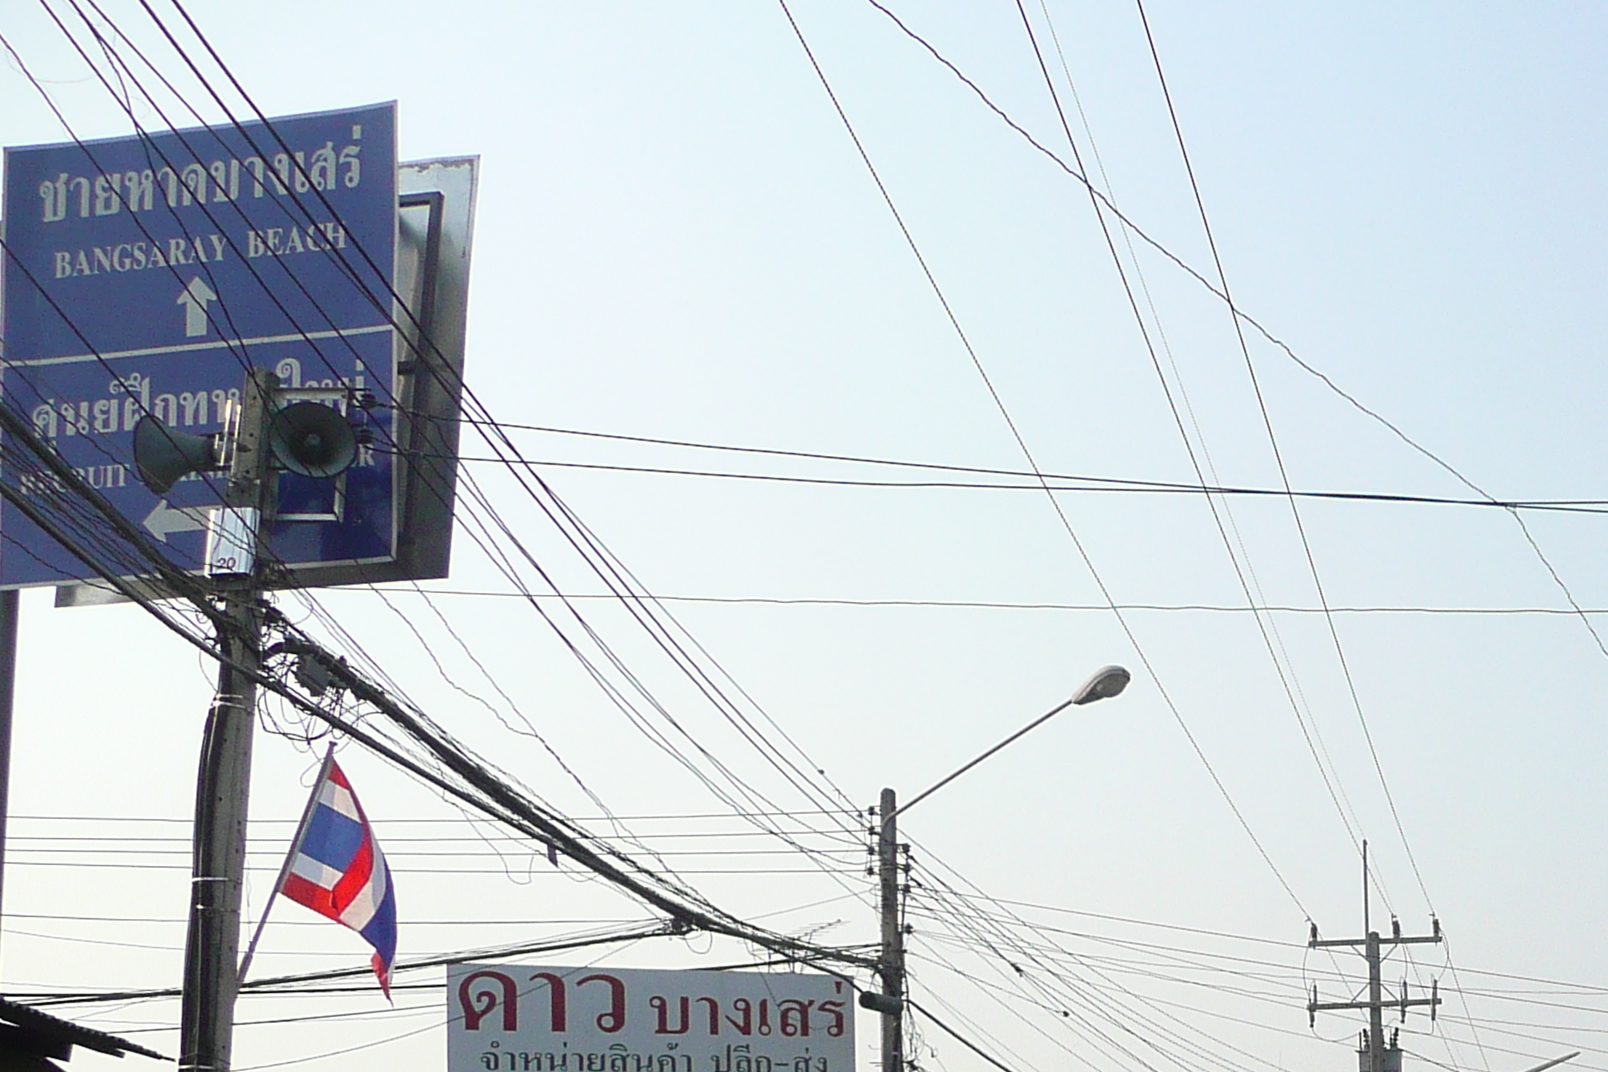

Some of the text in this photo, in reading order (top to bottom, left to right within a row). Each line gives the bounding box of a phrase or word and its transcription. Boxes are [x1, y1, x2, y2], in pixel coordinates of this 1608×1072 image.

[40, 124, 362, 223] ชายหาดบางเสร่
[54, 221, 349, 279] BANGSARAY BEACH
[458, 970, 846, 1038] ดาว บางเสร่
